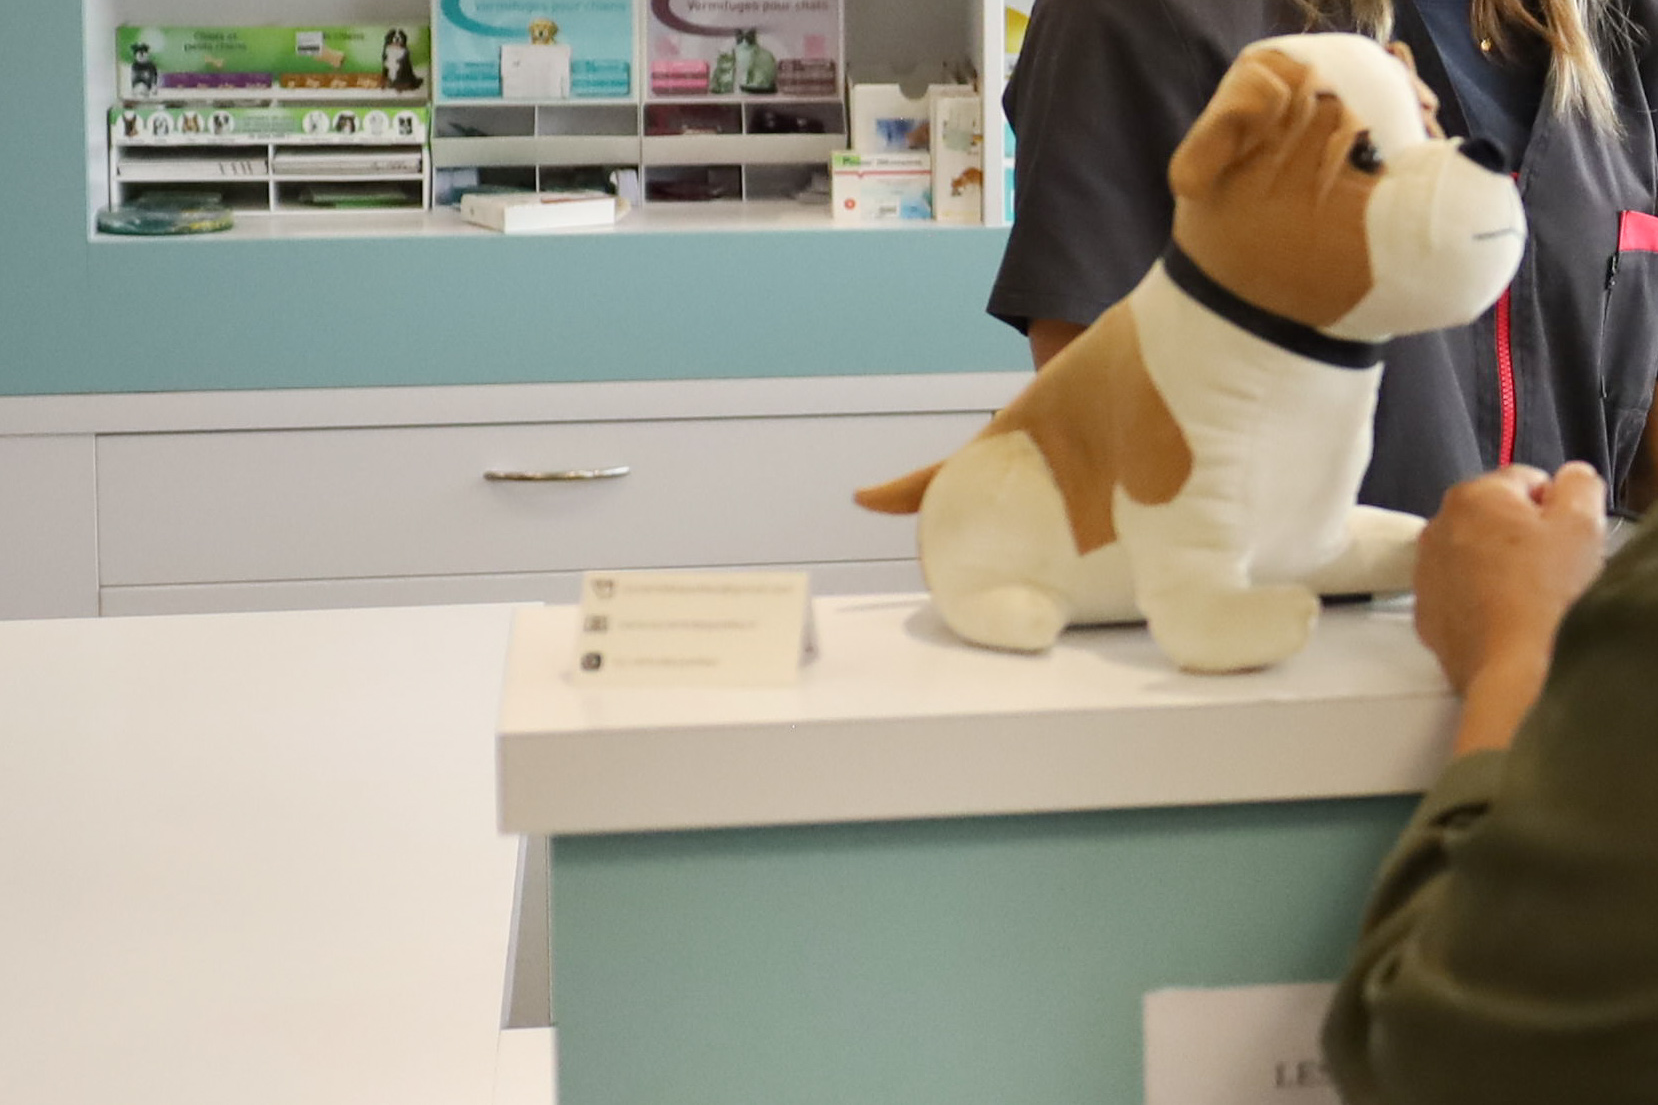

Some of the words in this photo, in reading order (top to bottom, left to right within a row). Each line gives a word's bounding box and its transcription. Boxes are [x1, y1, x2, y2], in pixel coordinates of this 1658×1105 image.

[688, 0, 759, 13] Vermifuges
[763, 1, 790, 12] pour
[795, 0, 829, 12] chats
